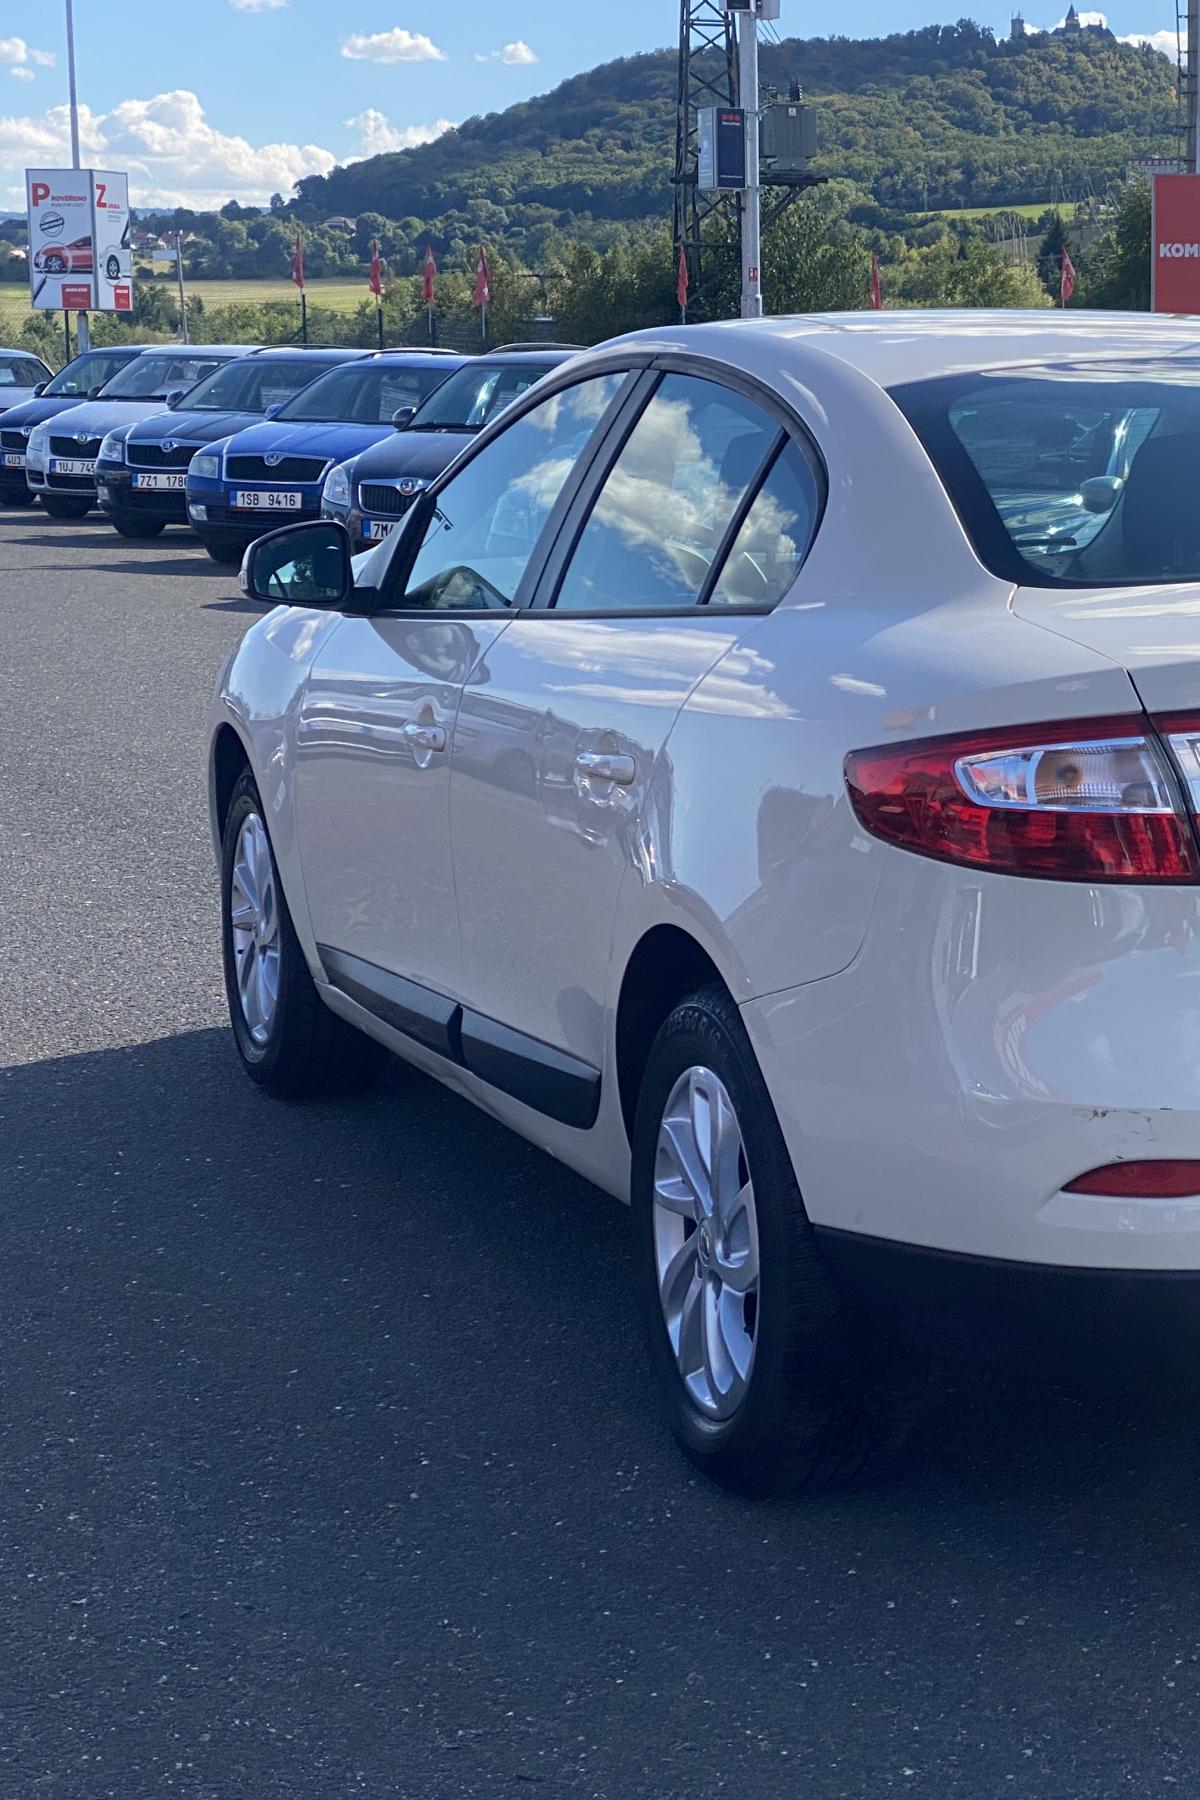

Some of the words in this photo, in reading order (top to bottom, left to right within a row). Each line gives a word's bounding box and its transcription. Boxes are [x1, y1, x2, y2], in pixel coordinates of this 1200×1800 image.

[58, 462, 74, 472] 1UJ
[140, 475, 157, 487] 7Z1
[239, 493, 259, 506] 1SB
[268, 494, 296, 507] 9416
